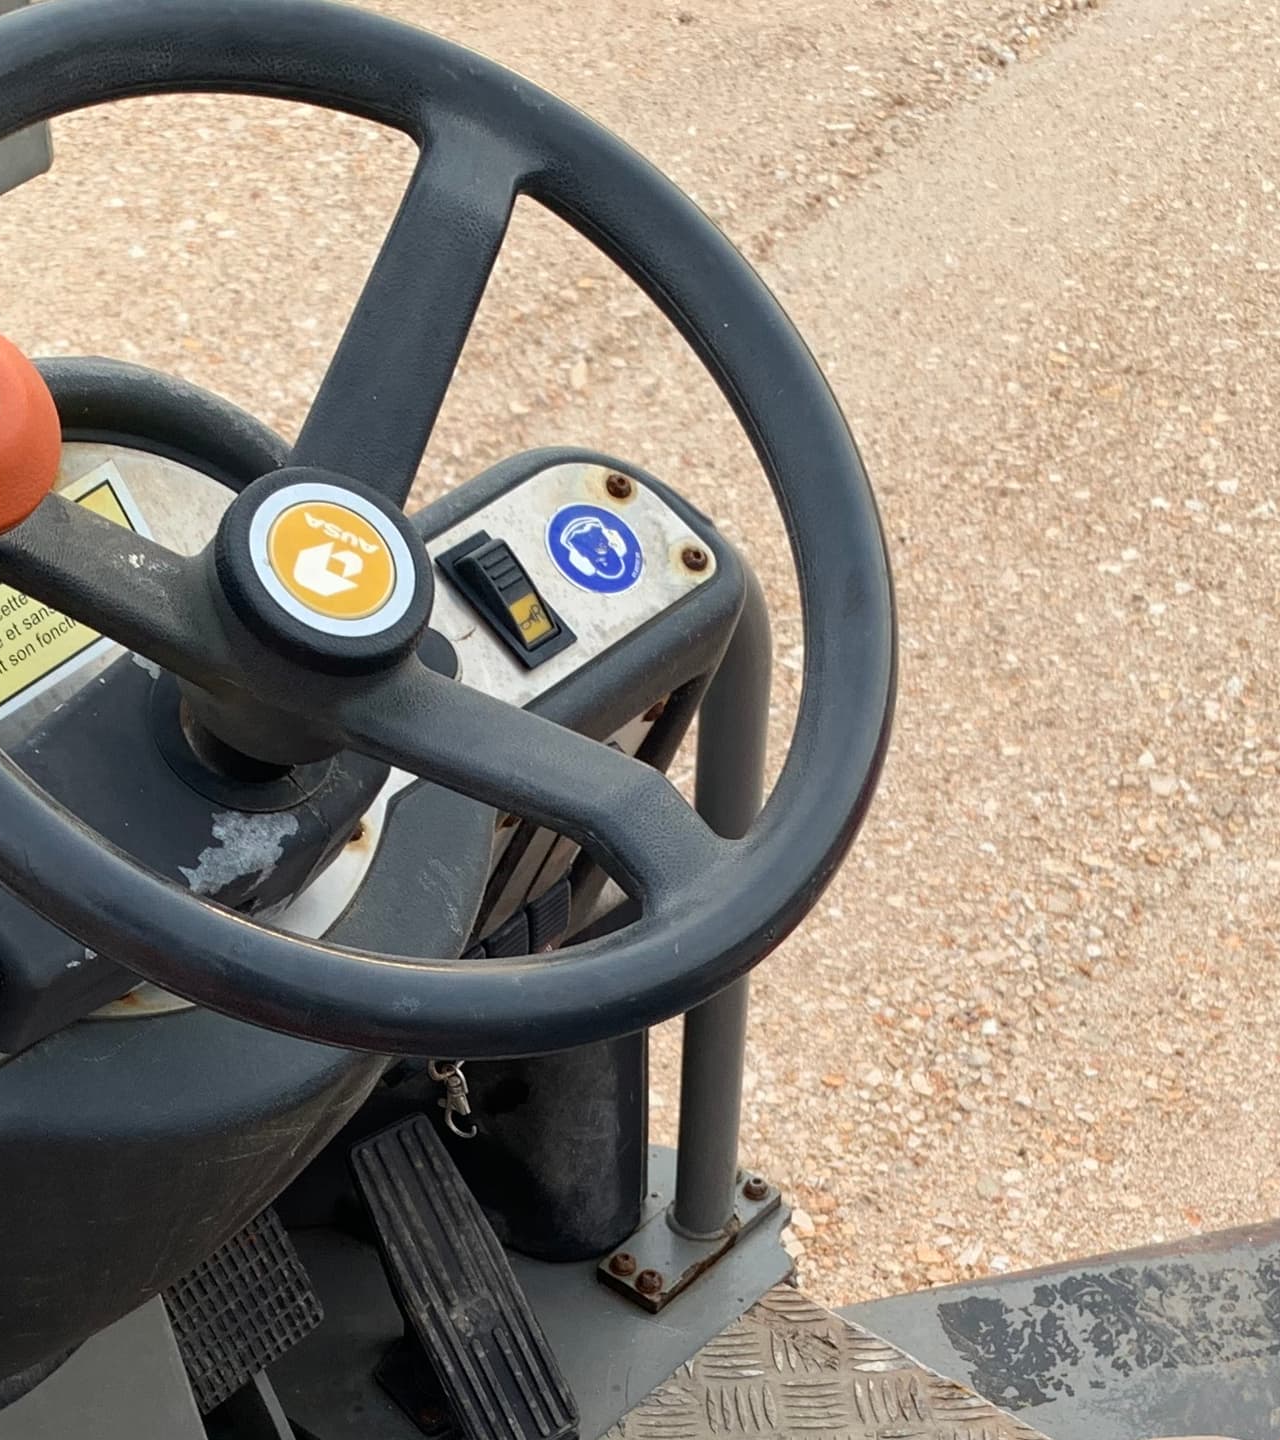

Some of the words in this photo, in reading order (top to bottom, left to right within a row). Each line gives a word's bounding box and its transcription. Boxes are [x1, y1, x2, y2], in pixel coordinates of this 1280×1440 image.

[304, 512, 380, 554] AUSA
[6, 623, 22, 641] et
[9, 643, 36, 666] son
